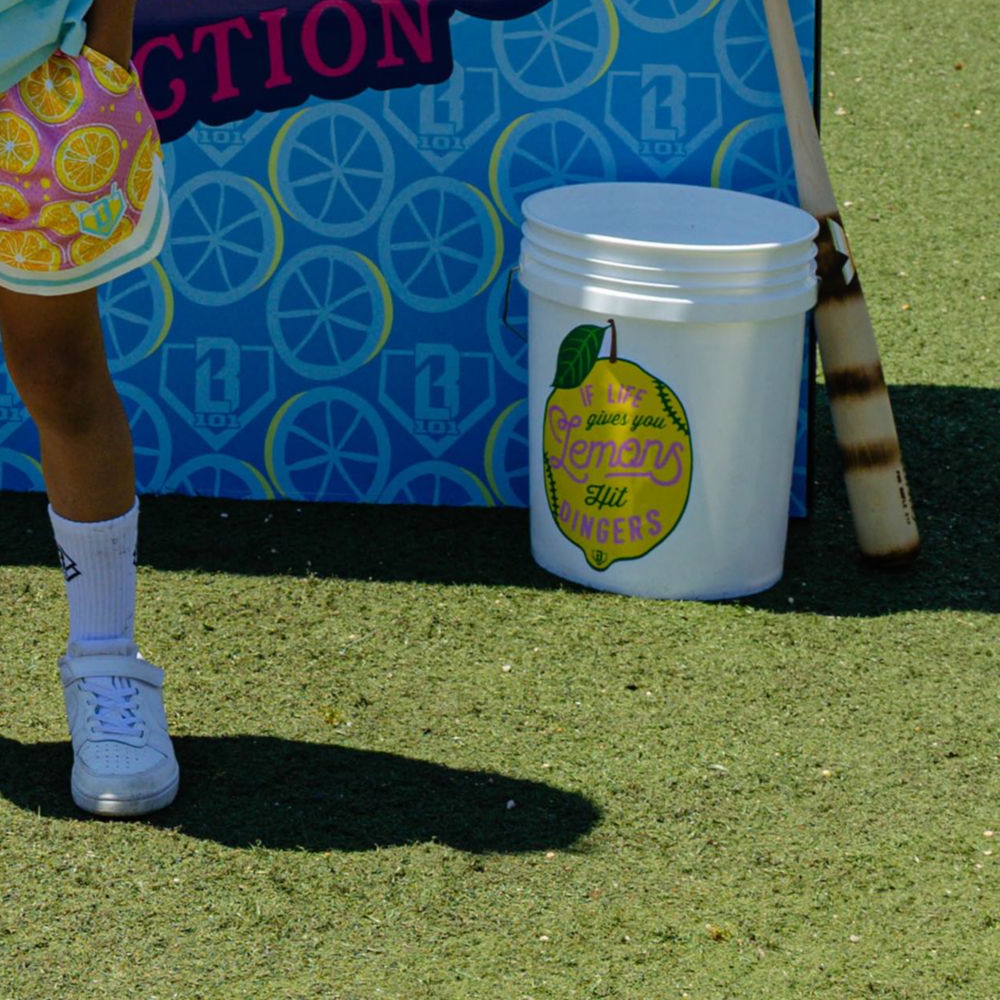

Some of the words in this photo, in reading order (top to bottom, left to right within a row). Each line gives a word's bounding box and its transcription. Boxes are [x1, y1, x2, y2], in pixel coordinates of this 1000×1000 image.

[579, 384, 594, 408] IF
[607, 383, 648, 409] LIFE
[585, 410, 628, 432] gives
[630, 412, 667, 432] you
[549, 405, 685, 487] Lemons
[584, 484, 629, 510] Hit
[558, 499, 663, 545] DINGERS
